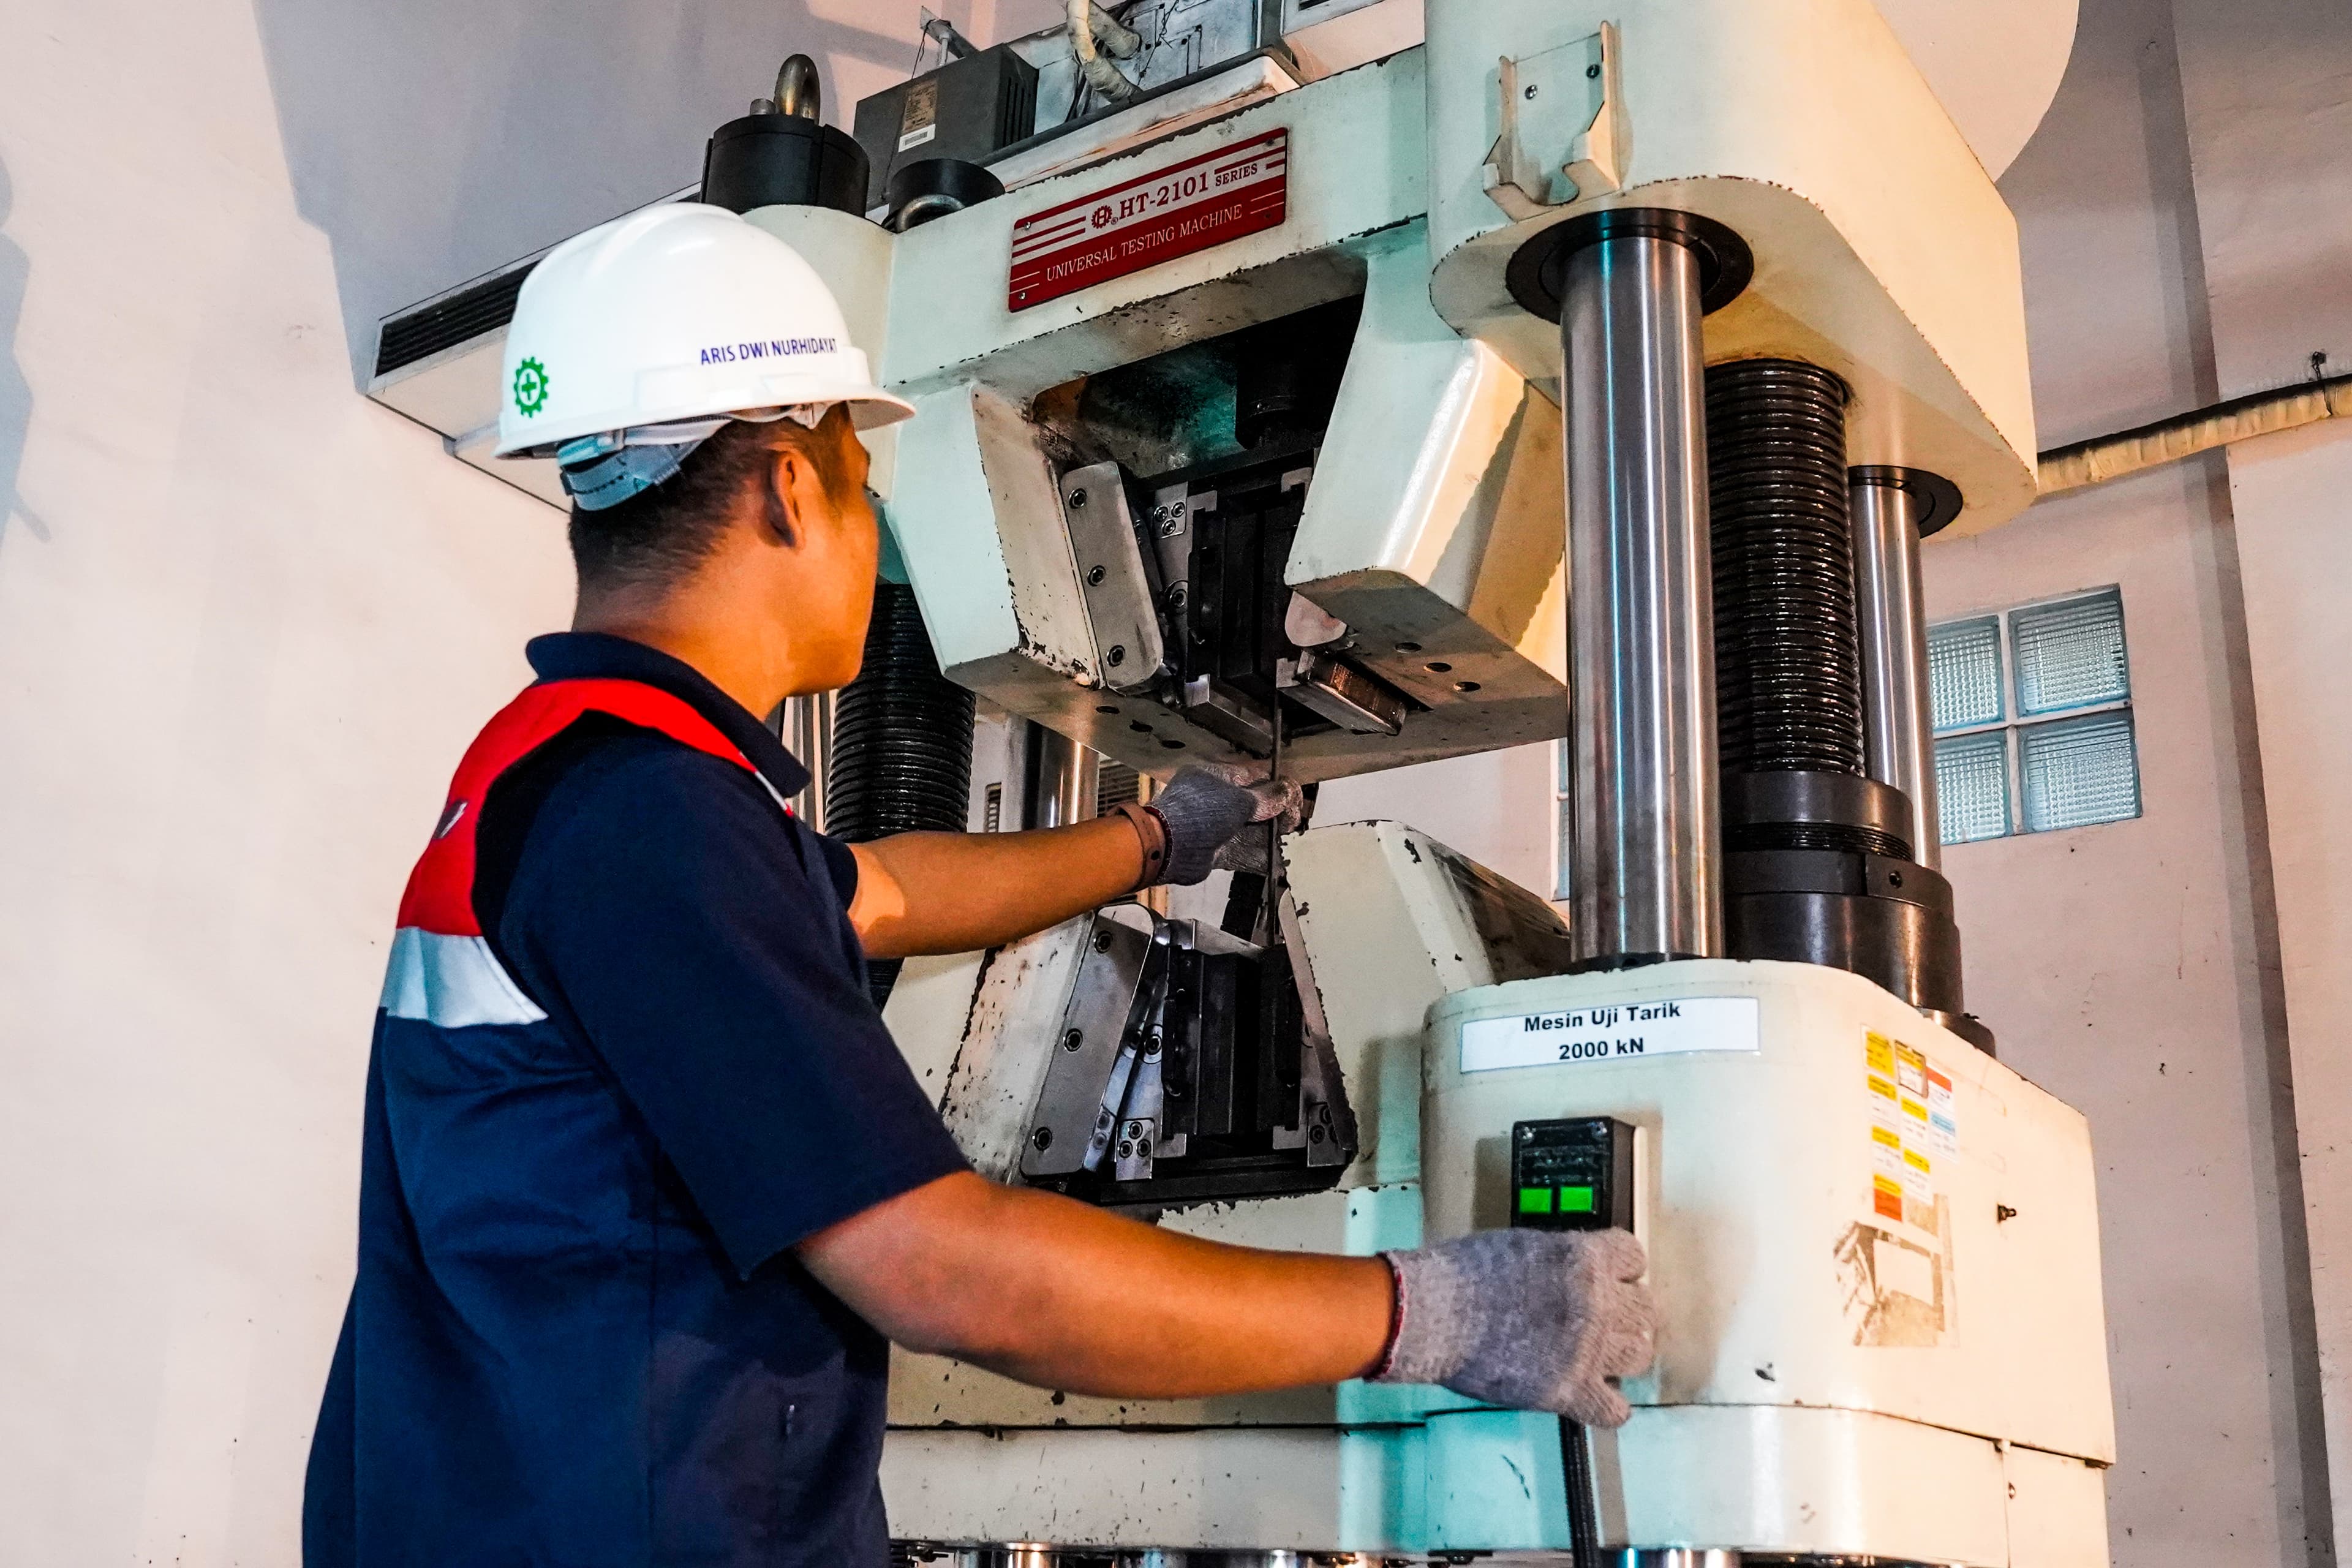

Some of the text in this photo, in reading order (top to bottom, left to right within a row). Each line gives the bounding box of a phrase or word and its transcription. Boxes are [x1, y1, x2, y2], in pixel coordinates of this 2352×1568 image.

[1119, 172, 1208, 219] HT-2101
[1215, 164, 1257, 187] SERIES
[1046, 204, 1243, 282] UNIVERSAL TESTING MACHINE
[701, 337, 838, 365] ARIS DWI NURHIDAYAT
[1524, 1002, 1681, 1032] Mesin Uji Tarik
[1559, 1037, 1645, 1060] 2000 kN
